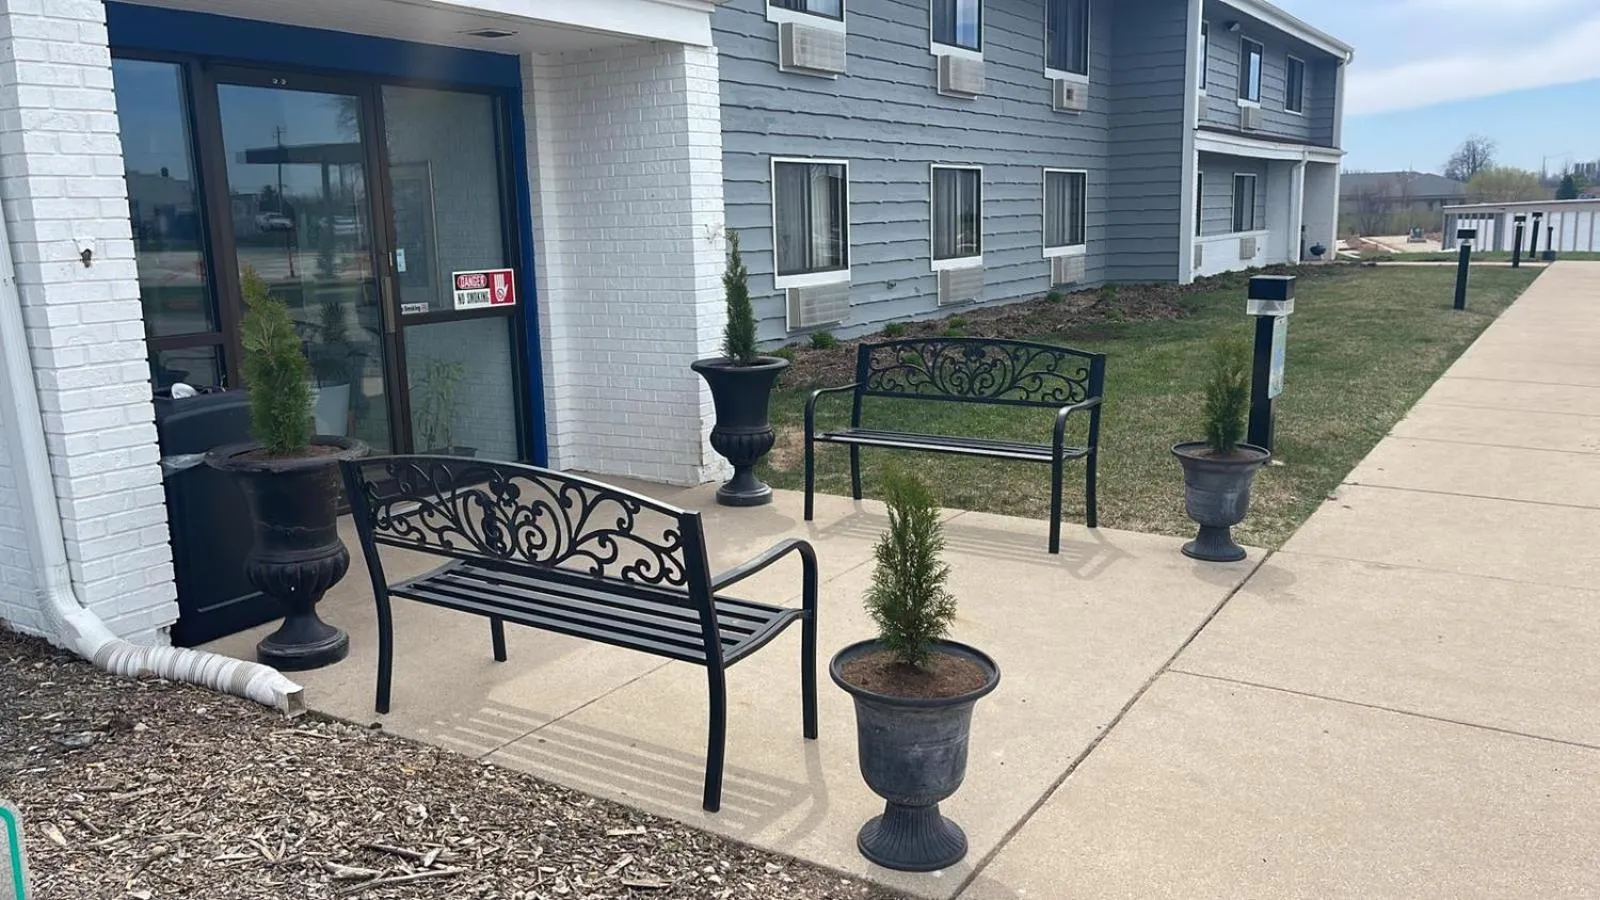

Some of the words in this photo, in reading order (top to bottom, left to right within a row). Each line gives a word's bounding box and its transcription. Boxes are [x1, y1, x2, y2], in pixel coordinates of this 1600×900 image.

[460, 275, 485, 289] DANGER
[457, 292, 465, 305] NO
[466, 291, 489, 304] SMOKING
